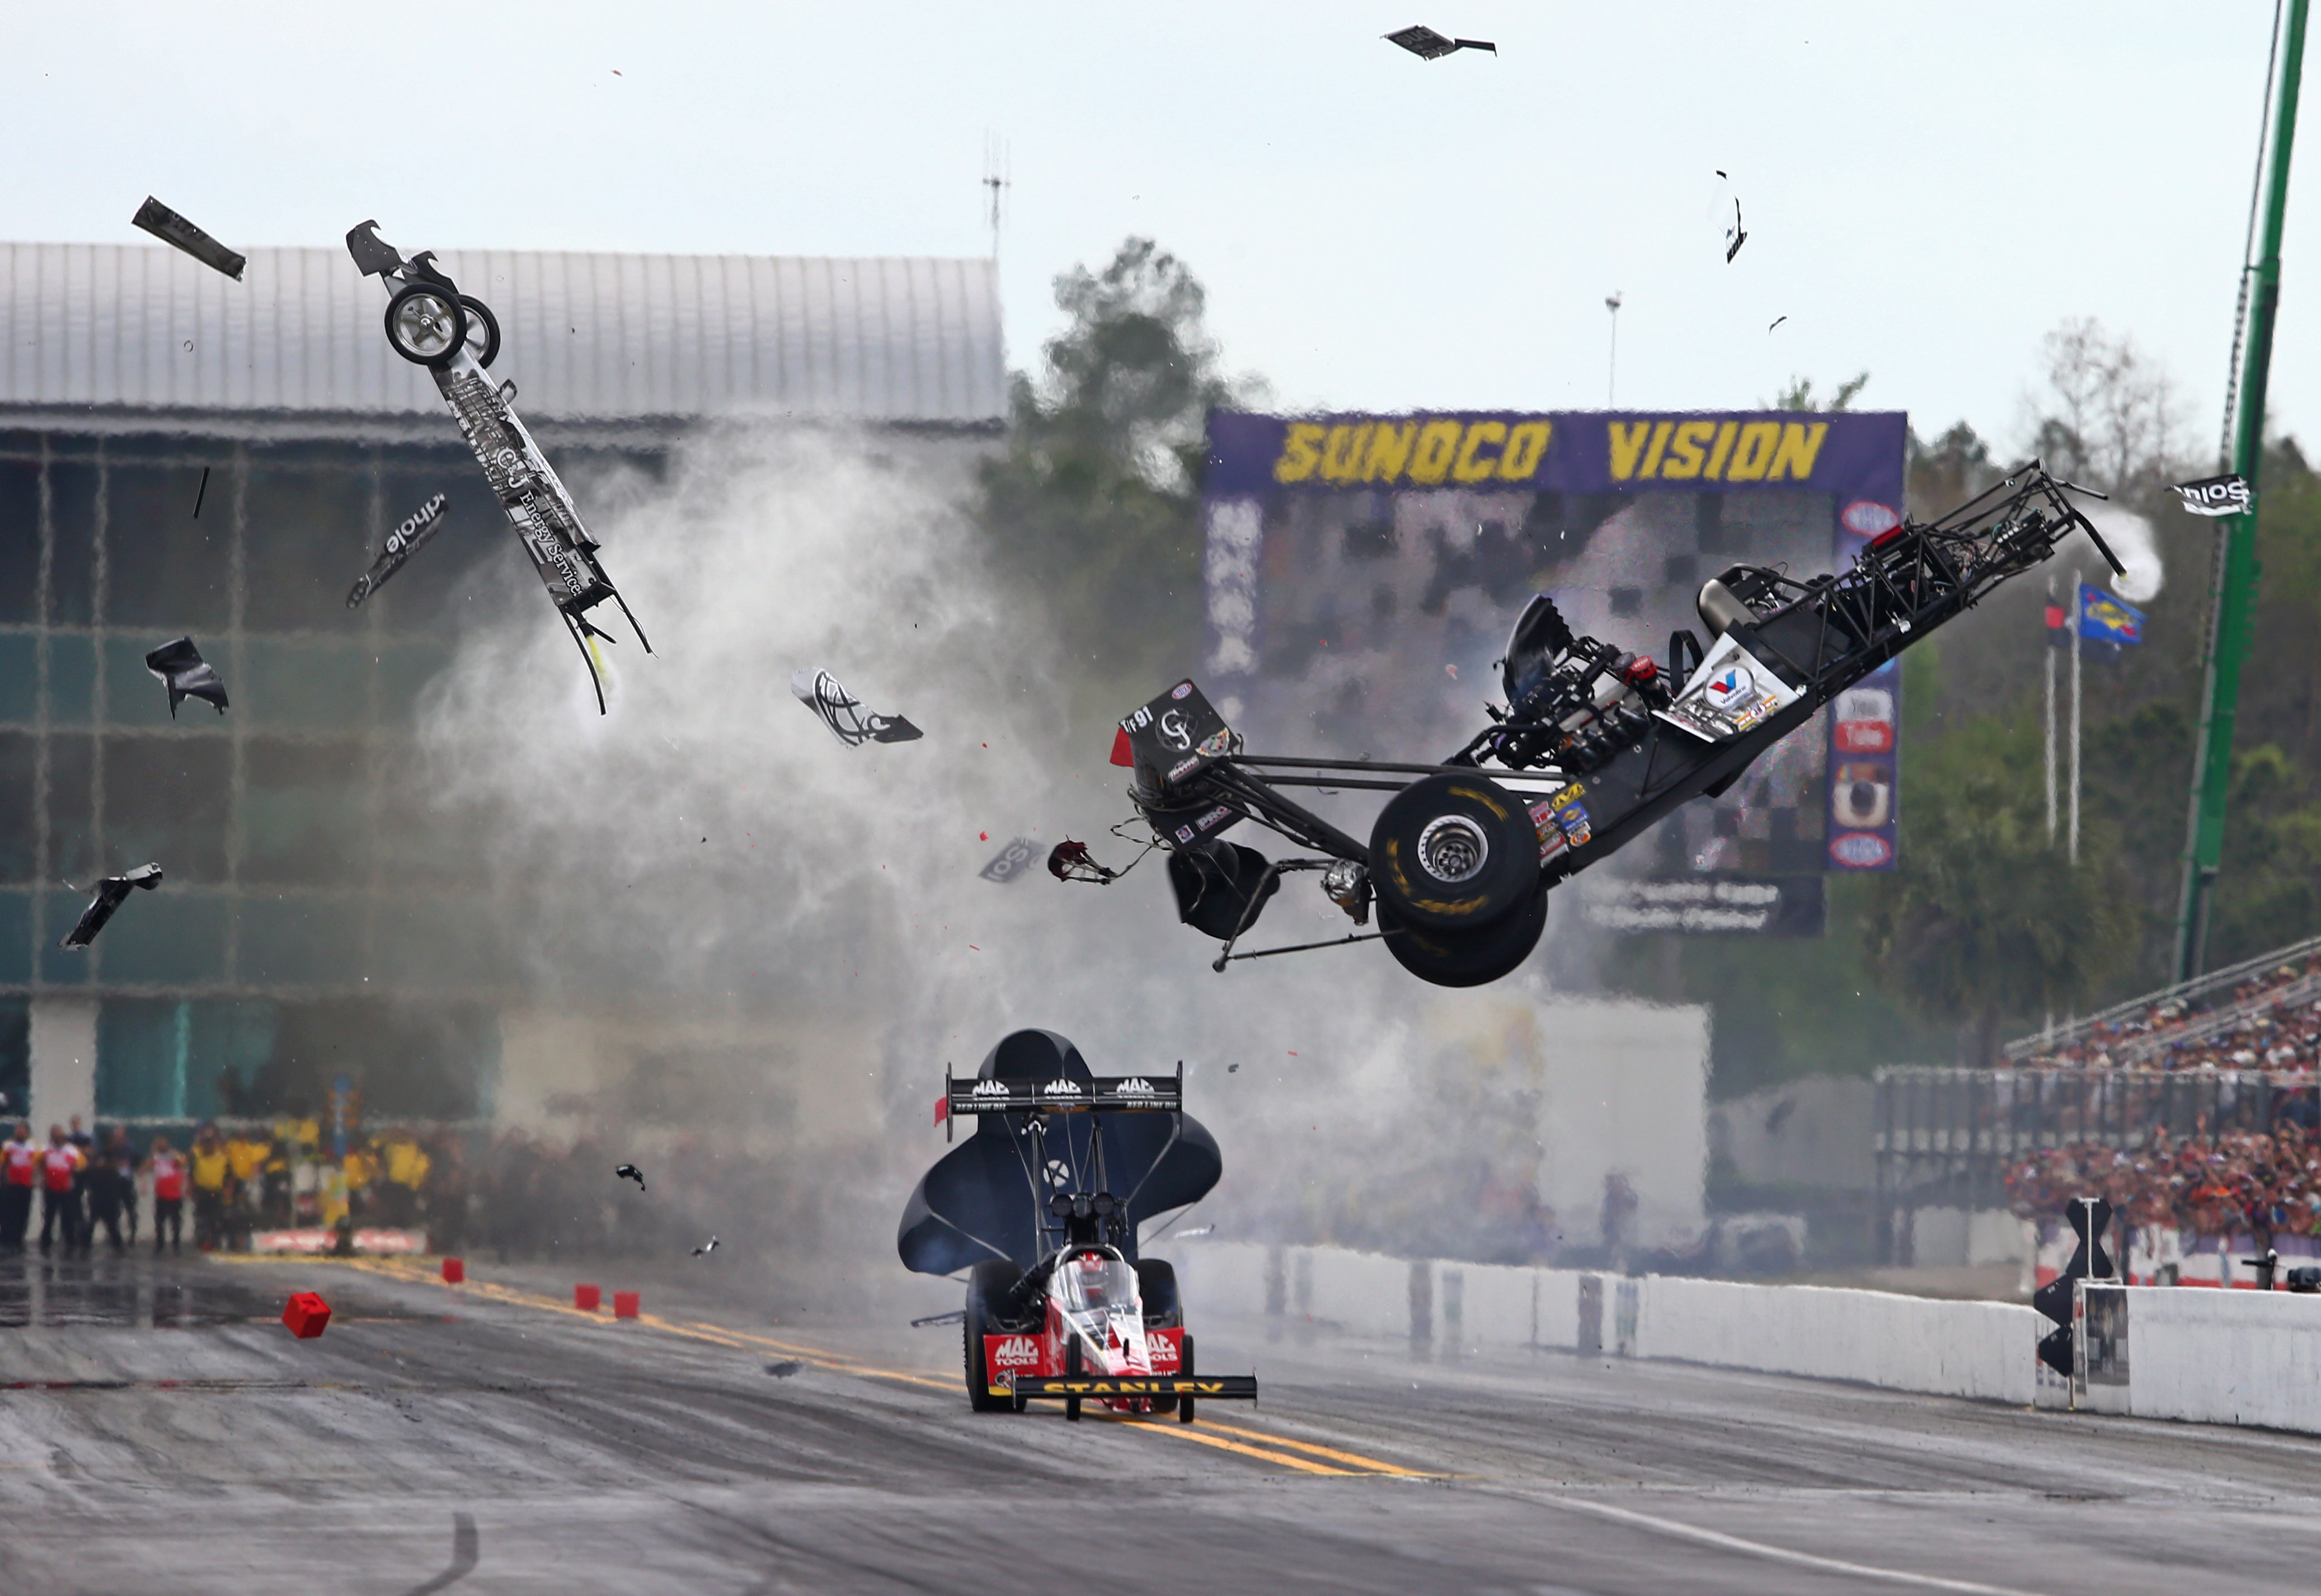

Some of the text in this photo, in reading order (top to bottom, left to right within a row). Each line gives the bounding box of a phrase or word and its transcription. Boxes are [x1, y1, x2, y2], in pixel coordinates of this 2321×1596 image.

[1274, 420, 1829, 484] SUNOCO VISION
[496, 448, 532, 489] C&J
[520, 490, 554, 547] Energy
[1720, 684, 1747, 705] Valvoline
[1134, 705, 1154, 727] 91
[972, 1079, 1010, 1095] MAC
[1044, 1078, 1082, 1095] MAC
[1116, 1077, 1155, 1093] MAC
[995, 1336, 1039, 1358] MAC
[1147, 1332, 1177, 1354] AC
[994, 1358, 1039, 1366] TOOLS
